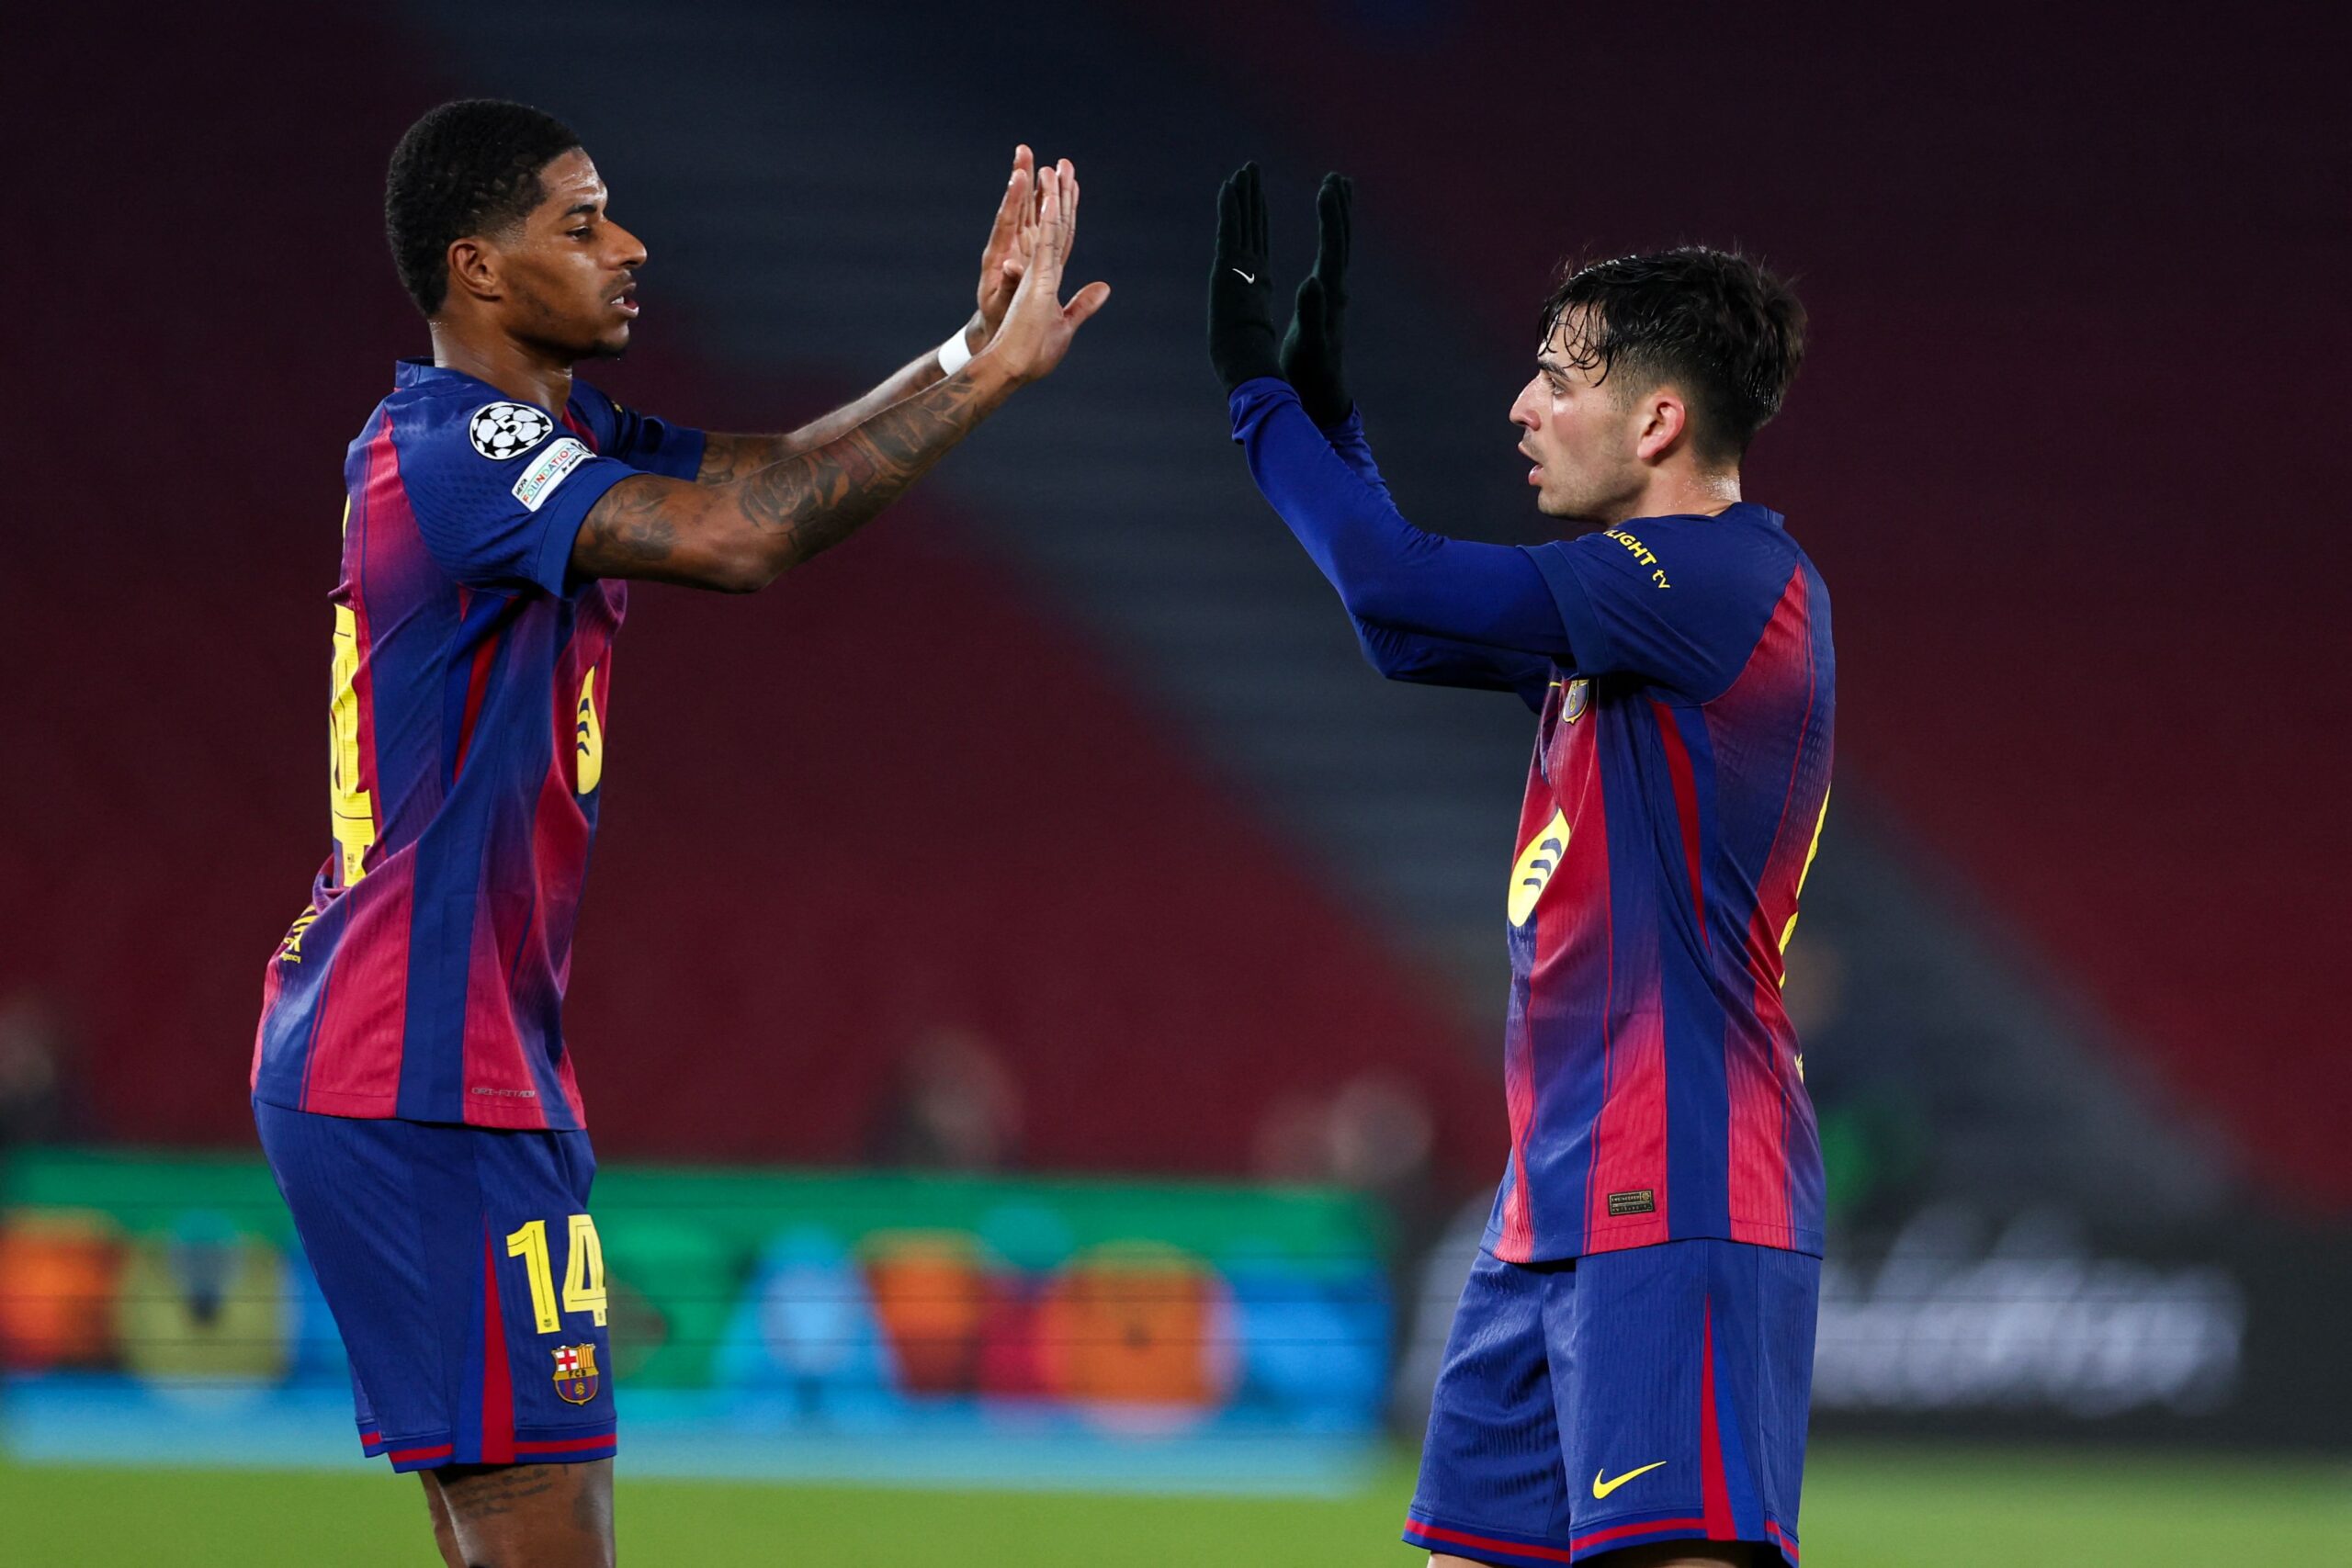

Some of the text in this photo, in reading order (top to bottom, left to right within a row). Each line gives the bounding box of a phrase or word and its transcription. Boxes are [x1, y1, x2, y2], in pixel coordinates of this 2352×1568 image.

[496, 414, 523, 436] 5
[522, 446, 575, 503] FOUNDATION
[506, 1214, 608, 1334] 14
